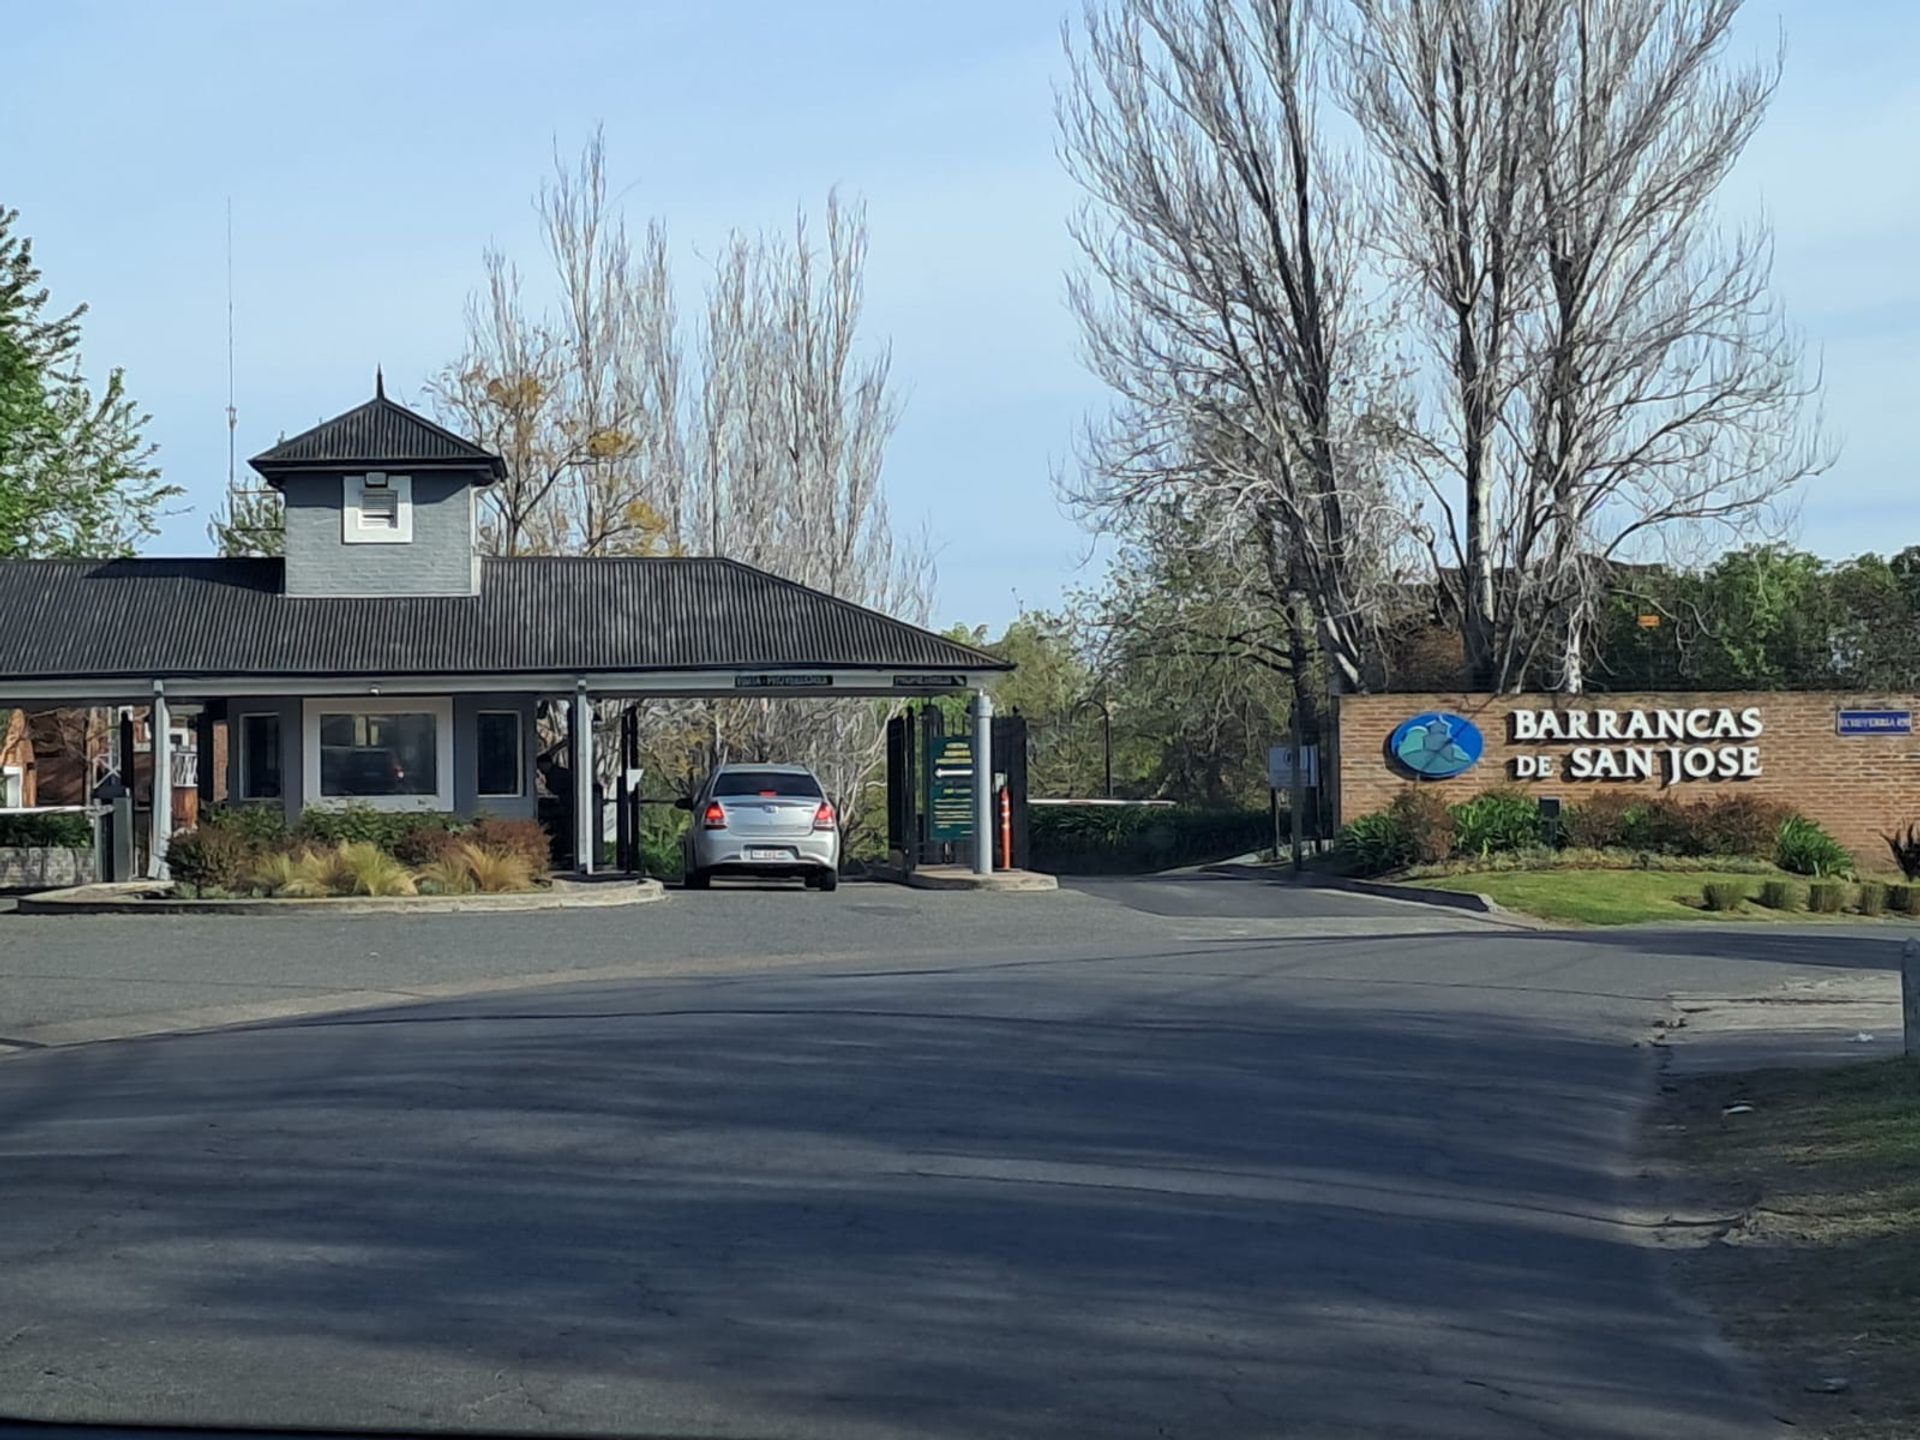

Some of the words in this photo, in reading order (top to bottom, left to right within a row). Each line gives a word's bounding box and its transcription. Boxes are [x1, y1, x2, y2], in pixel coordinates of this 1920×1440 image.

[1513, 708, 1764, 740] BARRANCAS
[1517, 755, 1553, 778] DE
[1570, 747, 1653, 778] SAN
[1668, 746, 1763, 786] JOSE
